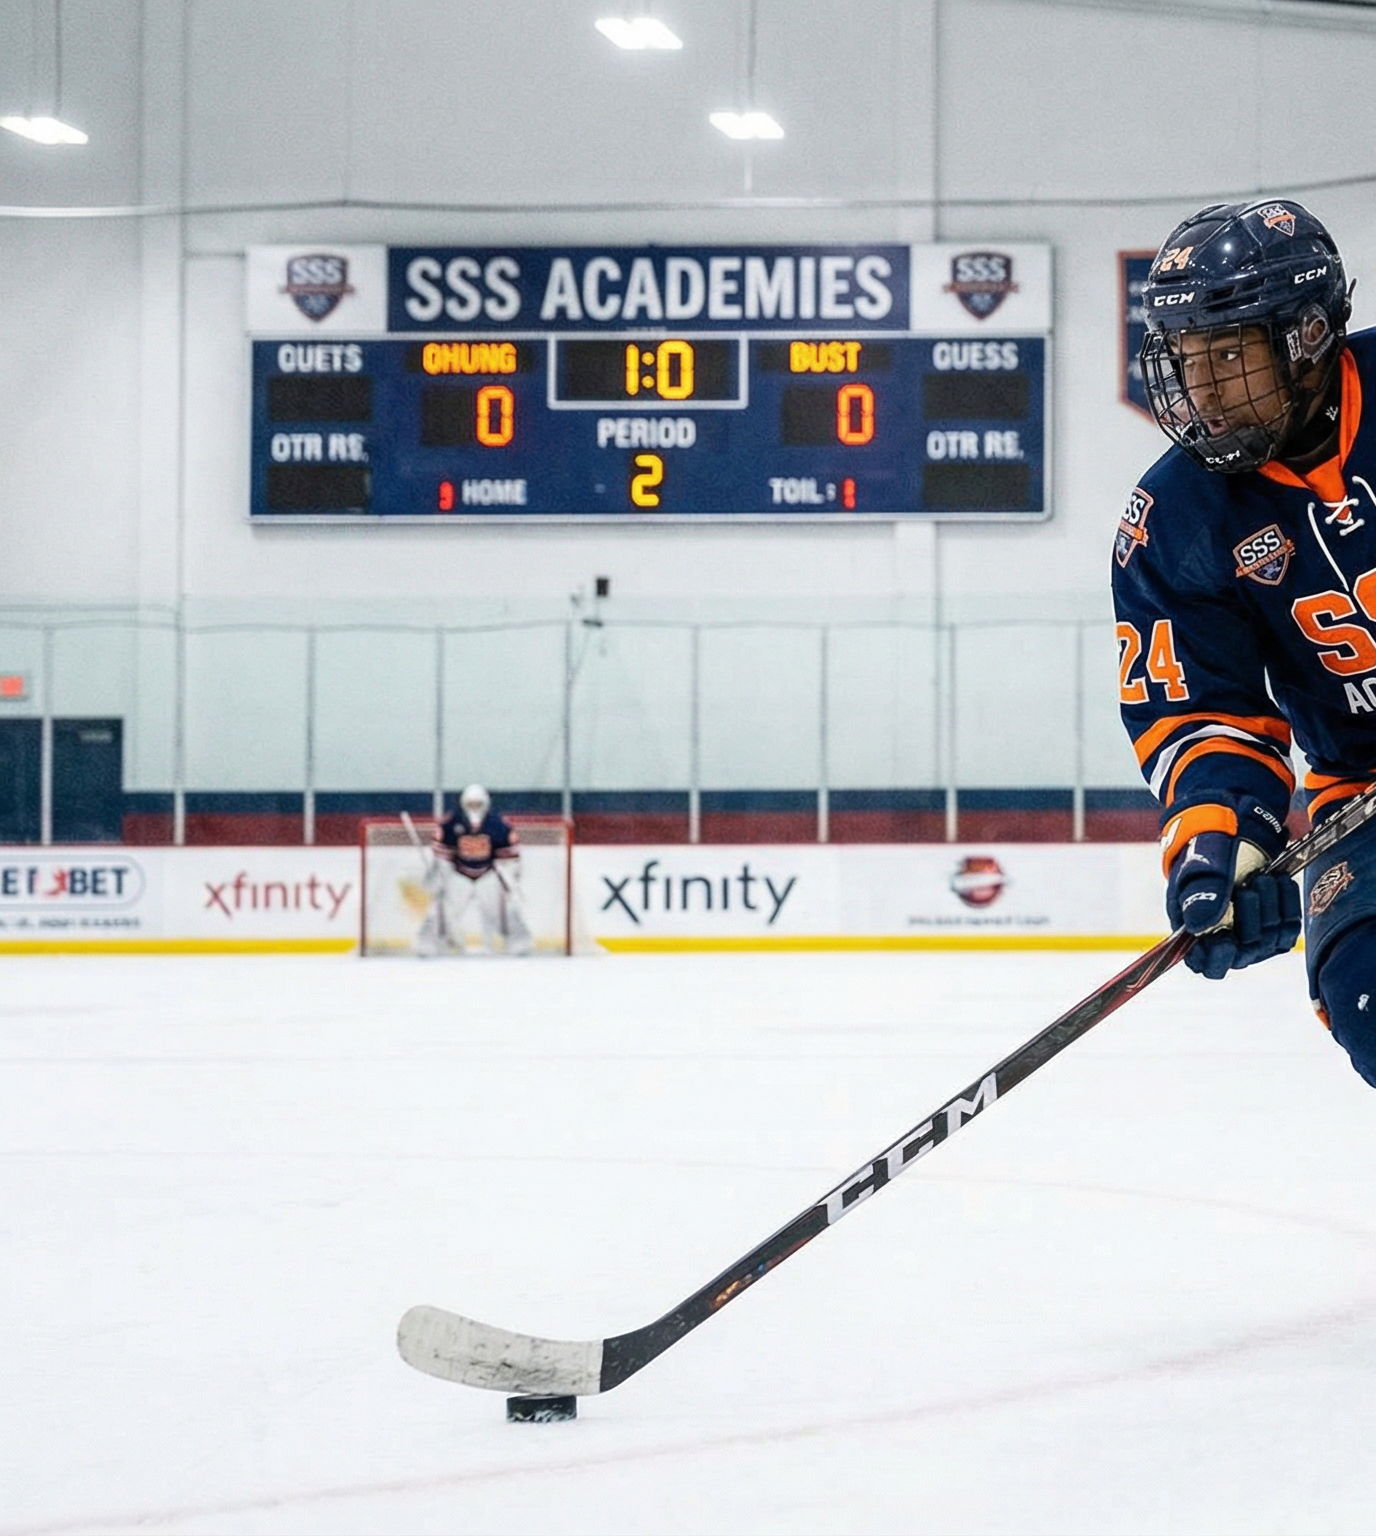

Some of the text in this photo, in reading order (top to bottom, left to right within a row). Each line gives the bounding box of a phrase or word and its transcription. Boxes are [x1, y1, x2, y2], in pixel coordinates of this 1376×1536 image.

[405, 255, 893, 322] SSS ACADEMIES
[1153, 291, 1196, 308] CCM
[476, 385, 515, 447] 0
[597, 417, 696, 449] PERIOD
[836, 382, 875, 446] 0
[461, 478, 528, 506] HOME
[631, 454, 663, 507] 2
[1240, 530, 1281, 565] SSS
[1116, 619, 1190, 704] 24
[204, 869, 353, 922] xfinity
[600, 860, 798, 926] xfinity
[826, 1071, 998, 1226] CCM
